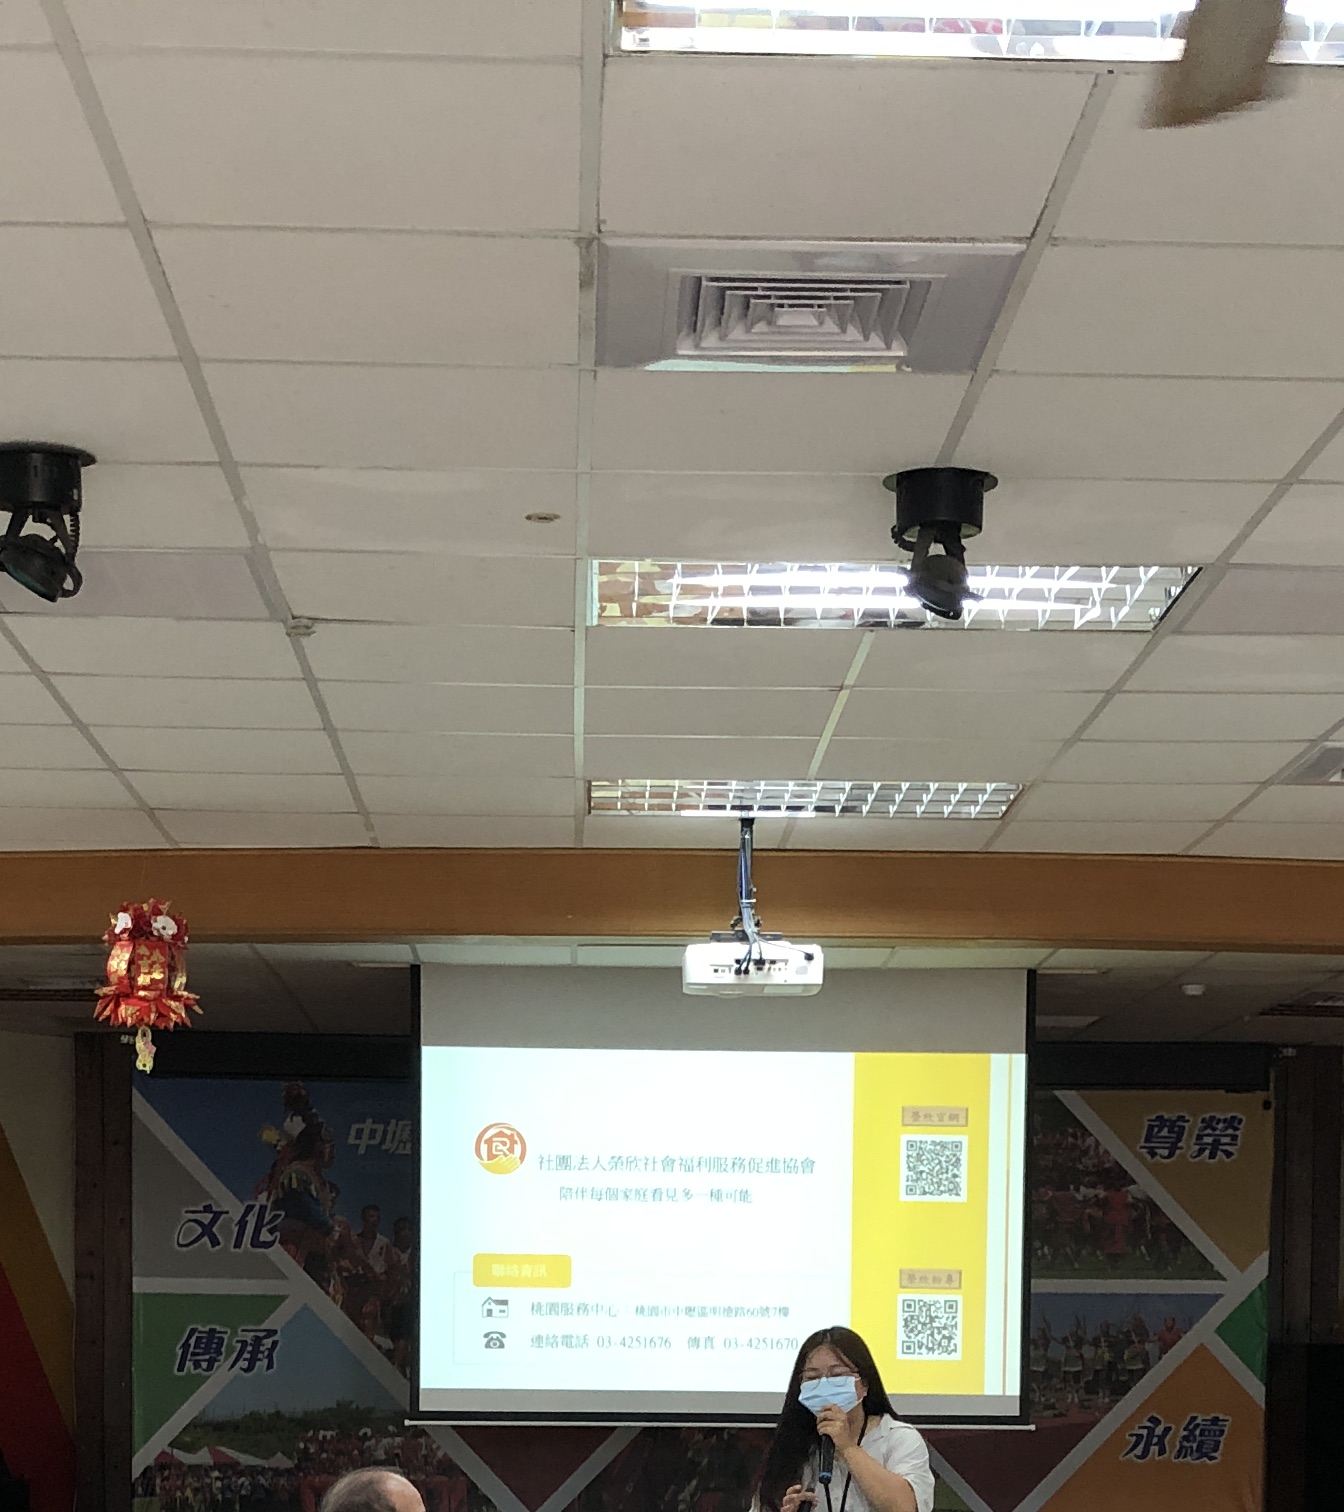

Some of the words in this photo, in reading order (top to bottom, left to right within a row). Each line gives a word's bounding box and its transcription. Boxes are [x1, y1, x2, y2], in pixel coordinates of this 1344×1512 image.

[1139, 1113, 1245, 1161] 尊榮
[538, 1153, 817, 1175] 社團法人榮欣社會福利服務促進協會
[175, 1203, 285, 1250] 文化
[175, 1326, 281, 1375] 傳承
[596, 1335, 673, 1350] 03-4251676
[687, 1335, 716, 1351] 傳真
[1120, 1413, 1232, 1463] 永續
